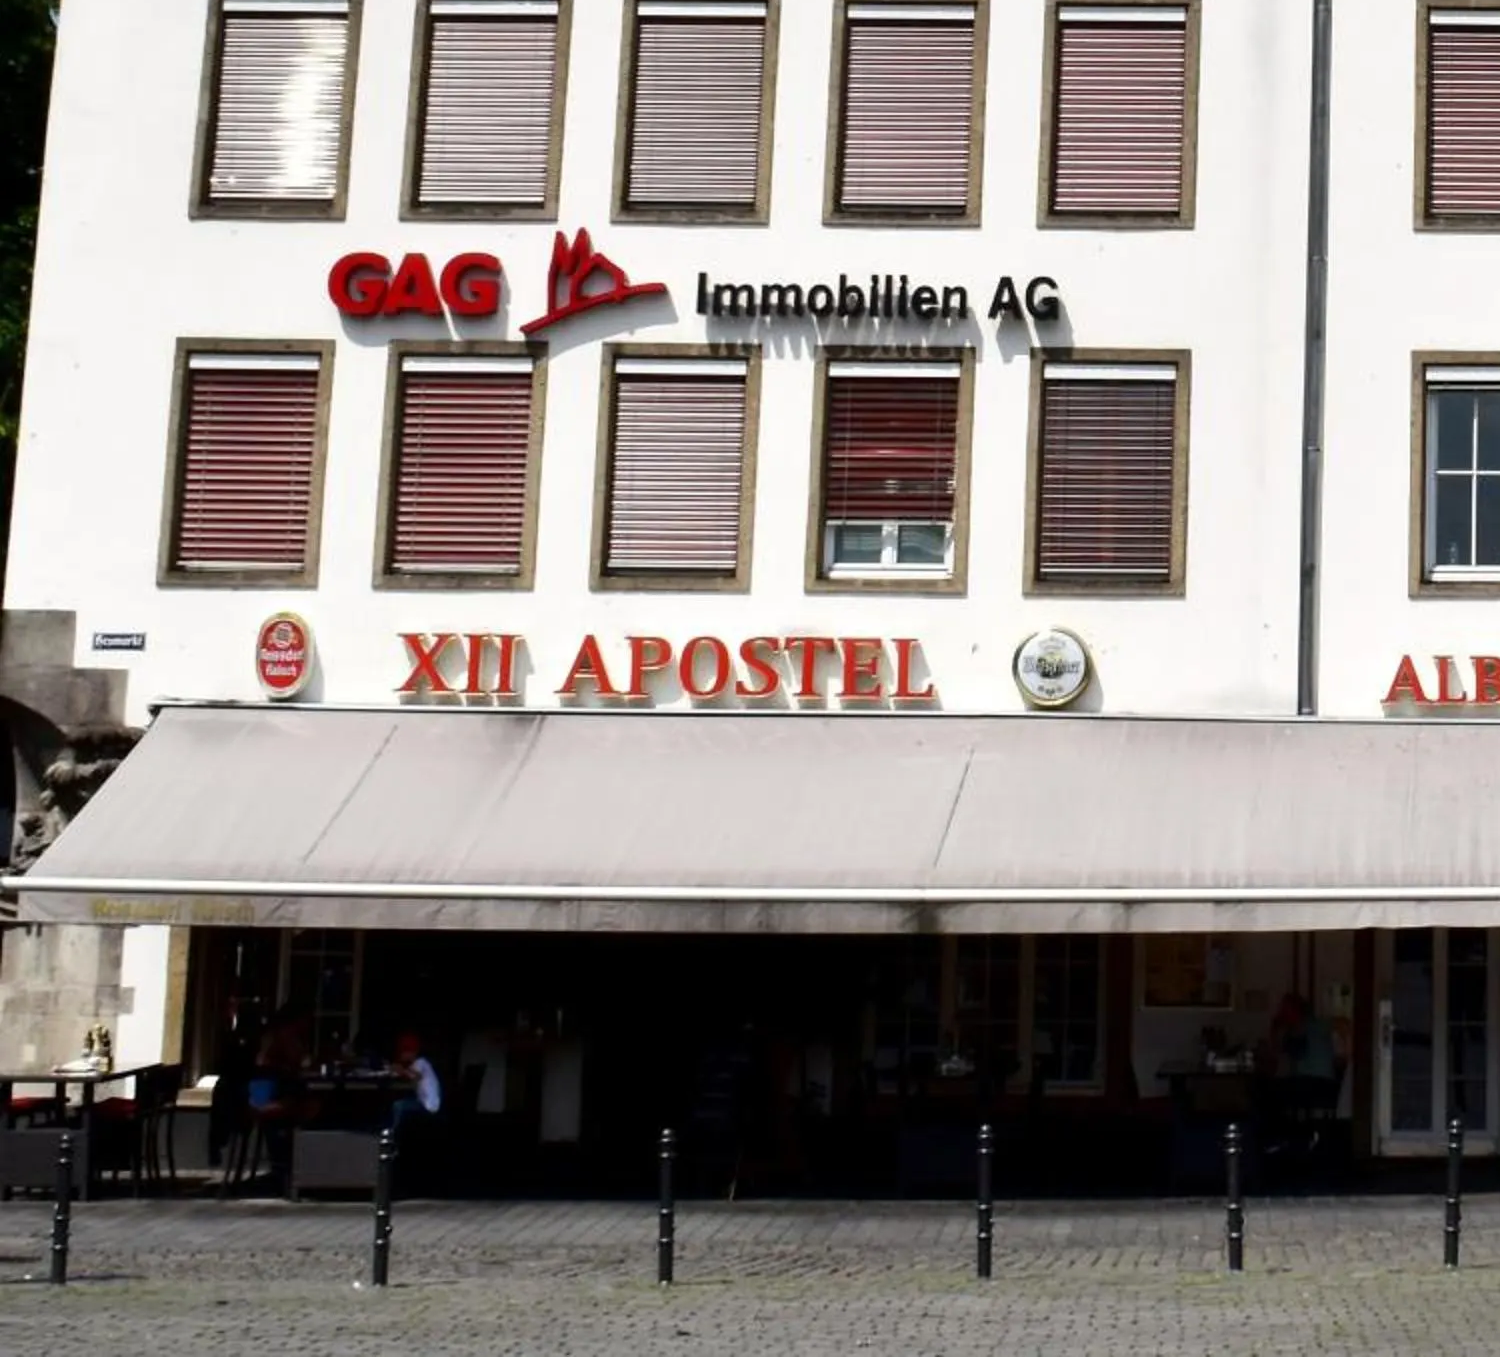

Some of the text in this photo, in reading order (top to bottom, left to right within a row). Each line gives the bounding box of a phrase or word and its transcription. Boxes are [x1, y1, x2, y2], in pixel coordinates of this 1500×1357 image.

[328, 252, 1060, 321] GAG Immobilien AG
[394, 632, 936, 701] XII APOSTEL
